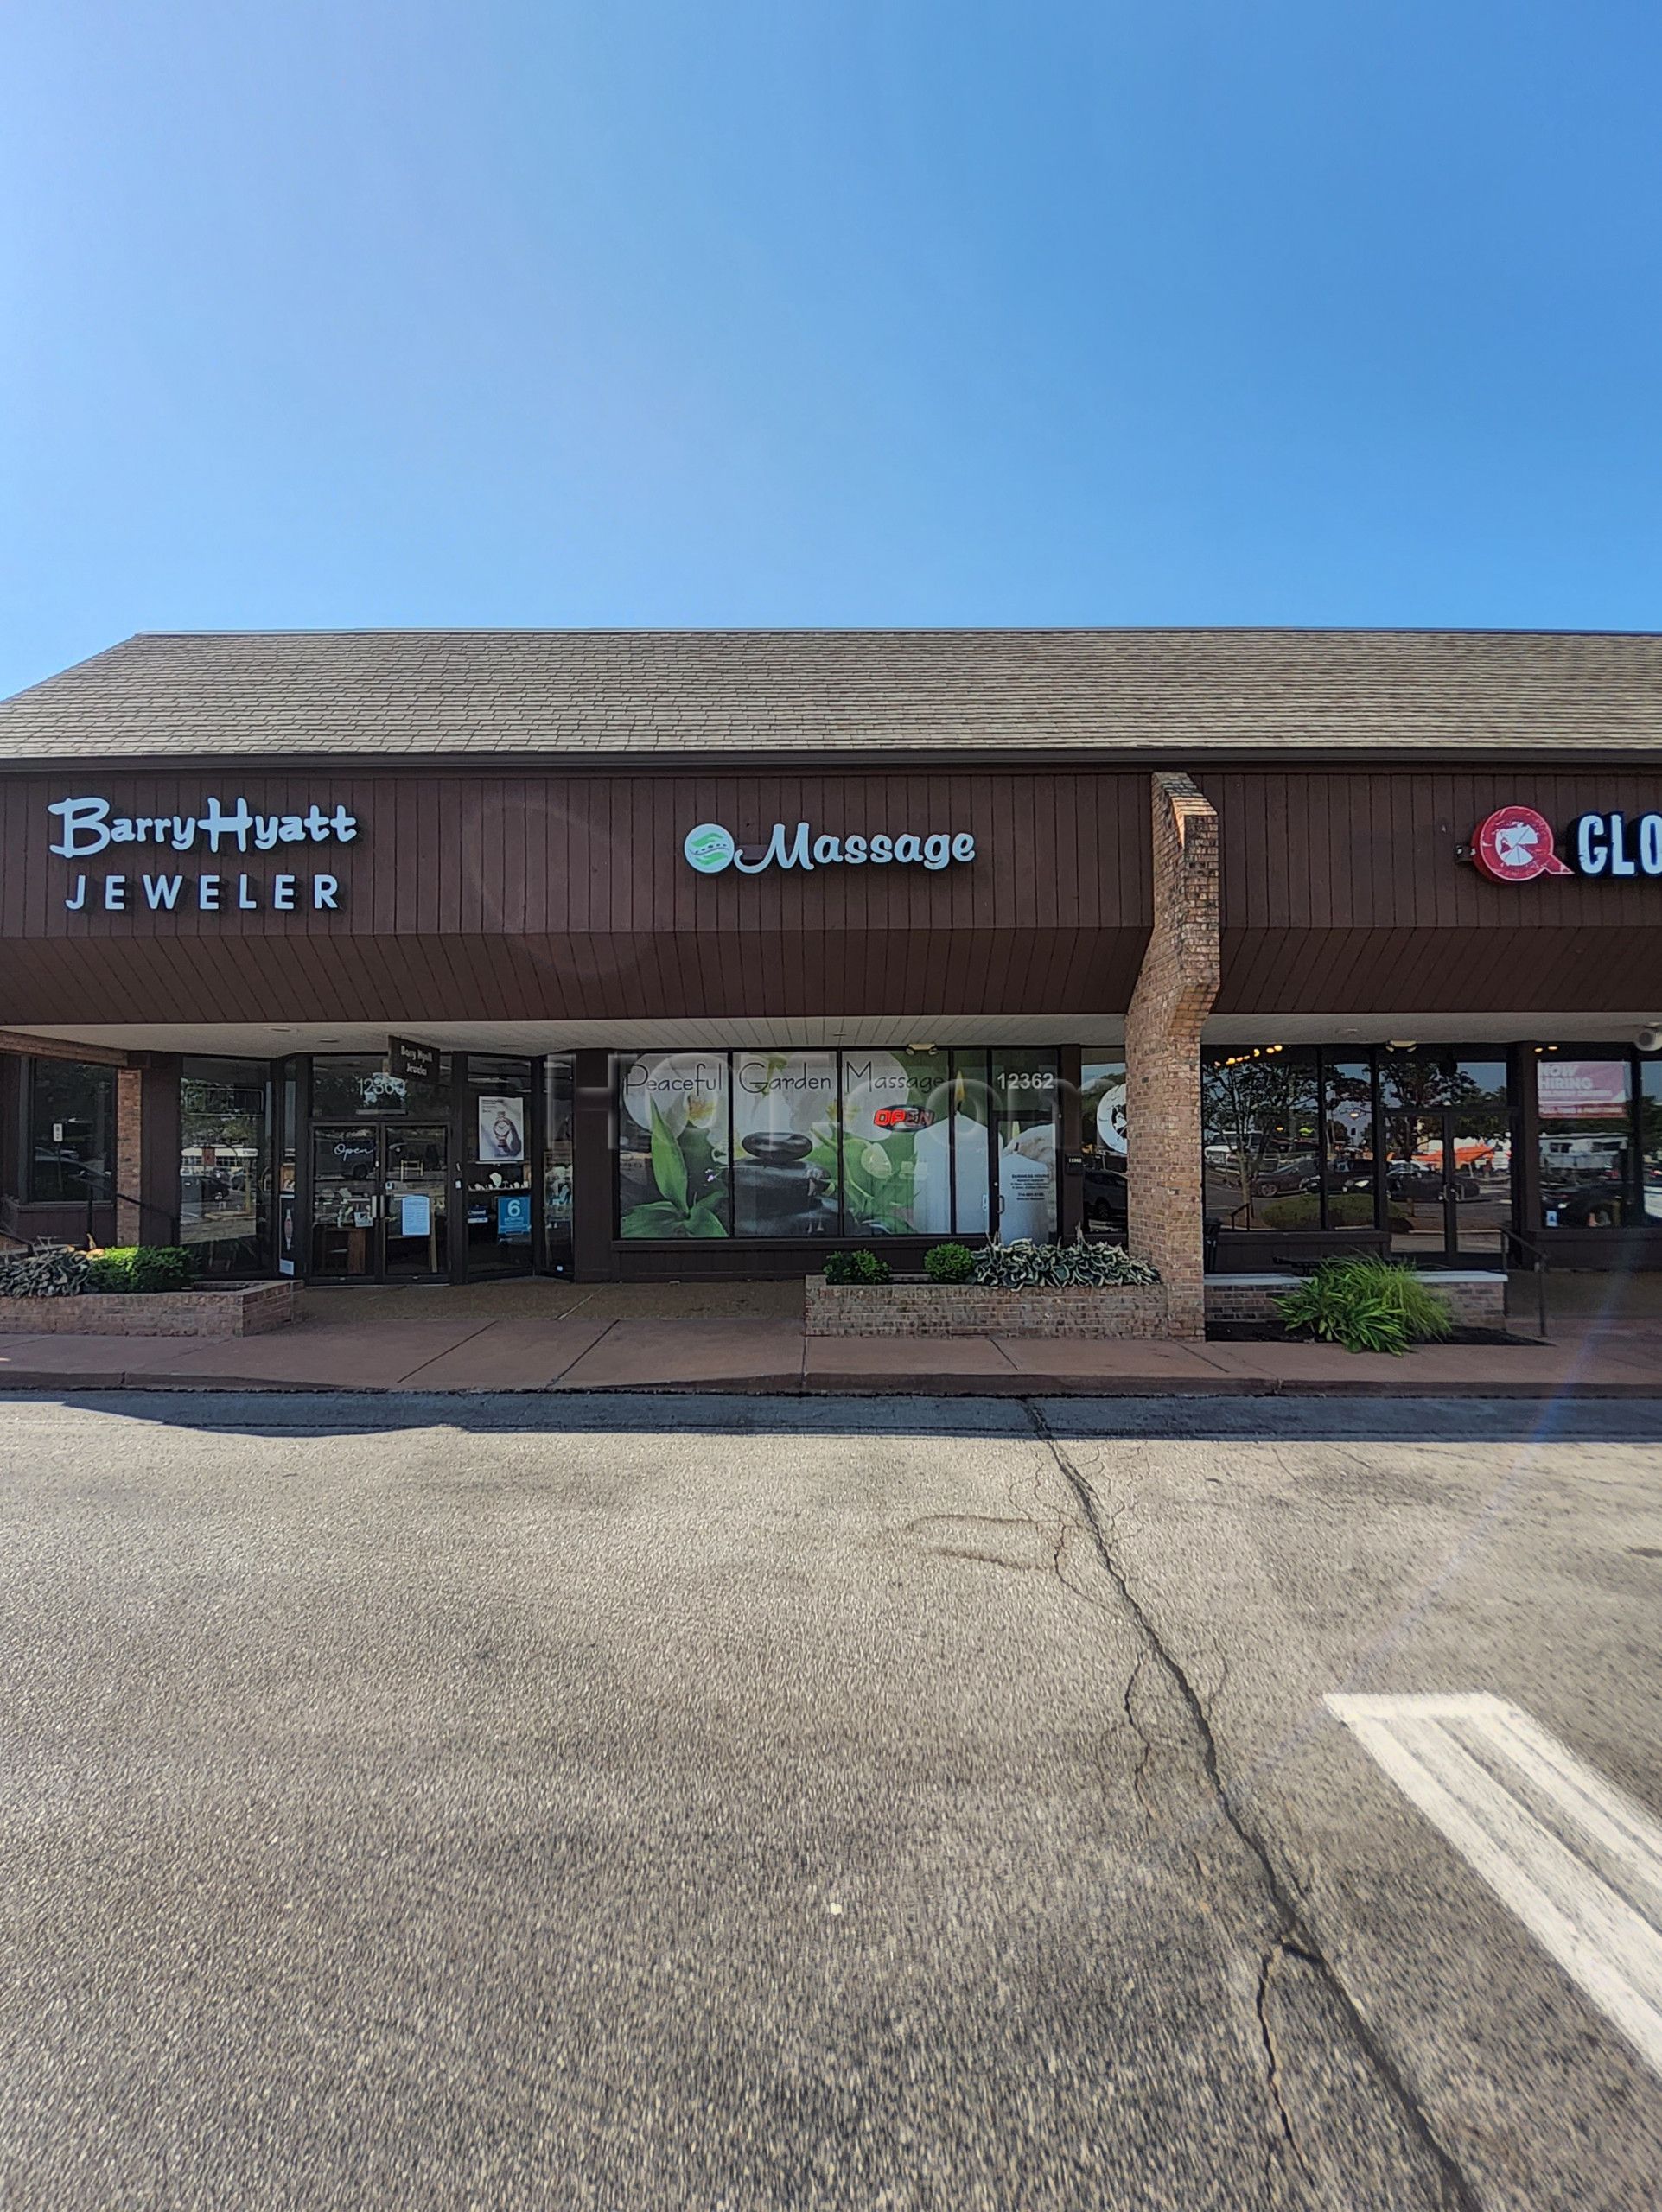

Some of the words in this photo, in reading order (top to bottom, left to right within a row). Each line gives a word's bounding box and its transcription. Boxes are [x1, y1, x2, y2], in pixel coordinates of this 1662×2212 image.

[47, 797, 197, 858] Barry
[197, 796, 357, 853] Hyatt
[733, 822, 977, 874] Massage
[65, 874, 340, 910] JEWELER
[624, 1063, 723, 1096] Peaceful
[738, 1063, 832, 1094] Garden
[844, 1063, 945, 1096] Massage
[997, 1072, 1054, 1090] 12362
[874, 1109, 934, 1127] OPEN
[334, 1142, 375, 1161] Open
[507, 1199, 521, 1217] 6
